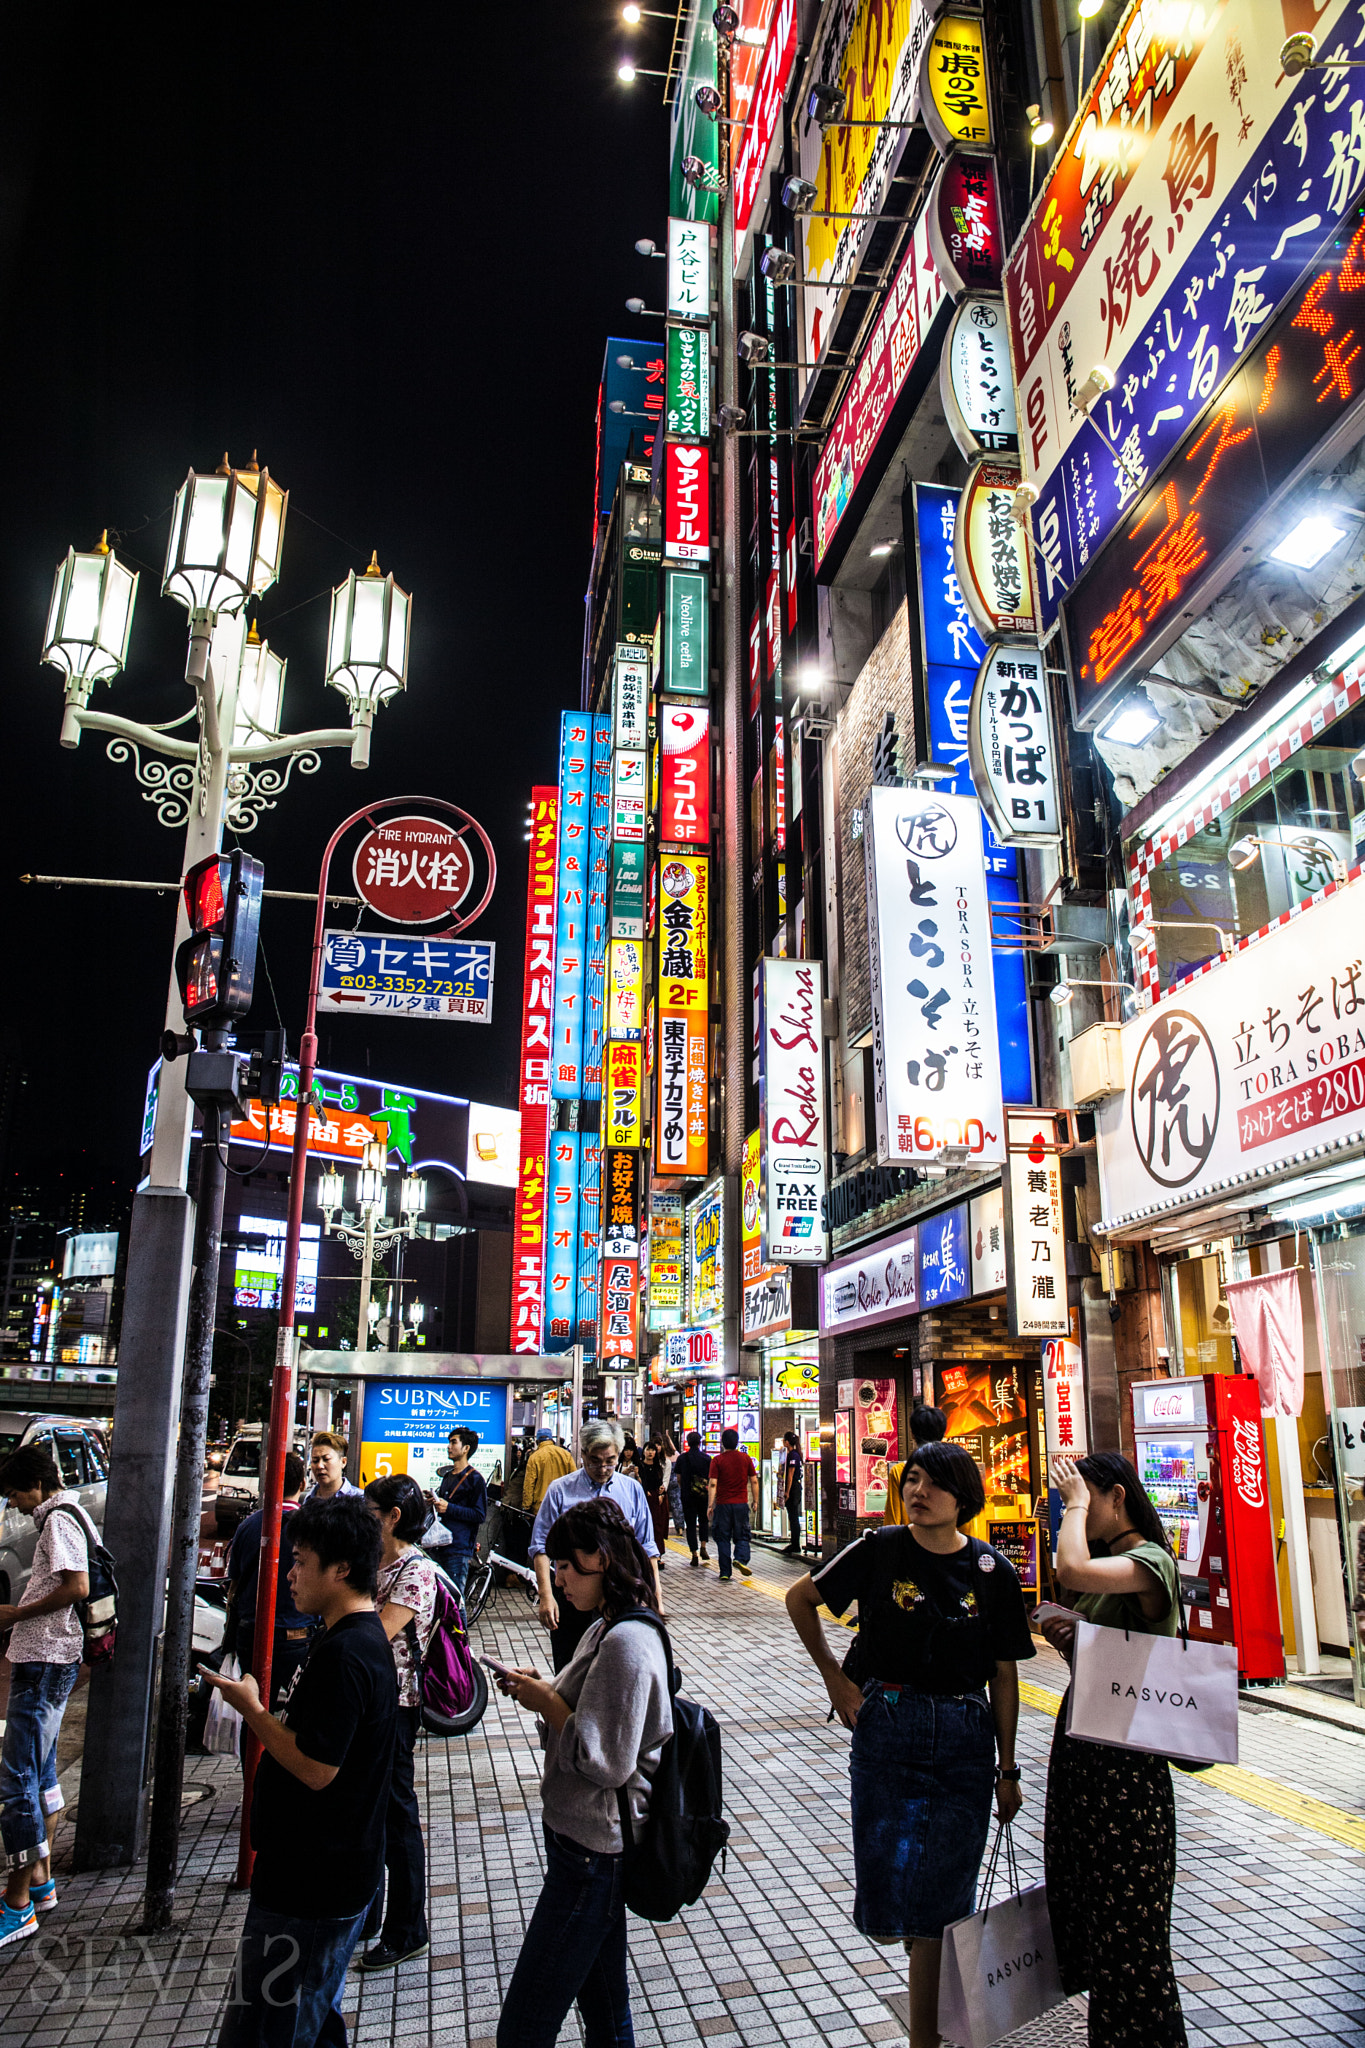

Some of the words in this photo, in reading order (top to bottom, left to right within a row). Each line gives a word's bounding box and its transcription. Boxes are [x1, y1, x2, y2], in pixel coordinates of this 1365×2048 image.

[936, 52, 983, 117] 虎の子
[957, 126, 986, 140] 4F
[1241, 159, 1278, 222] VS
[950, 234, 963, 262] 3F
[1100, 113, 1220, 360] 焼鳥
[677, 229, 702, 304] 戸谷ビル
[681, 311, 697, 320] 7F
[892, 305, 915, 358] TAX
[972, 305, 996, 328] 虎
[892, 324, 917, 390] FREE
[978, 331, 1006, 427] とらそば
[676, 342, 700, 435] もみの気ハウス
[667, 409, 680, 432] 6F
[979, 433, 1009, 449] 1F
[1026, 376, 1049, 472] 6F
[676, 466, 701, 542] アイフル
[678, 546, 698, 557] 5F
[986, 492, 1022, 613] お好み焼き
[1039, 496, 1064, 602] 5F
[1080, 511, 1209, 684] 営業
[997, 615, 1035, 632] 2階
[996, 660, 1038, 681] 新宿
[986, 691, 1003, 778] 生ビール190円酒場
[1000, 680, 1048, 786] かっぱ
[673, 757, 698, 821] アコム
[1010, 797, 1047, 821] B1
[378, 828, 402, 842] FIRE
[405, 830, 453, 846] HYDRANT
[535, 799, 557, 896] パチンコ
[674, 824, 697, 838] 3F
[365, 846, 463, 892] 消火栓
[617, 921, 638, 936] 3F
[955, 886, 970, 935] TORA
[625, 943, 641, 973] お好み
[660, 899, 694, 980] 金の蔵
[355, 974, 476, 997] 03-3352-7325
[906, 859, 959, 1093] とらそば
[960, 939, 974, 988] SOBA
[369, 992, 442, 1013] アルタ裏
[447, 998, 485, 1015] 買取
[616, 990, 636, 1024] 焼き
[668, 983, 698, 1006] 2F
[768, 966, 820, 1054] Shira
[1232, 959, 1365, 1071] 立ちそば
[628, 1028, 640, 1039] 7F
[689, 1036, 706, 1066] 元祖
[961, 998, 984, 1080] 立ちそば
[611, 1045, 638, 1089] 麻雀
[1240, 1059, 1299, 1101] TORA
[1307, 1026, 1365, 1073] SOBA
[611, 1088, 637, 1127] ブル
[662, 1020, 688, 1162] 東京チカラめし
[687, 1066, 706, 1136] 焼き牛丼
[770, 1063, 820, 1149] Roko
[1138, 1017, 1214, 1168] 虎
[614, 1130, 632, 1144] 6F
[897, 1114, 914, 1153] 早朝
[1240, 1087, 1314, 1145] かけそば
[521, 1155, 544, 1244] パチンコ
[611, 1151, 634, 1225] お好み焼
[775, 1182, 817, 1197] TAX
[776, 1197, 818, 1211] FREE
[550, 1144, 573, 1338] カラオケ館
[607, 1224, 637, 1240] 本陣
[611, 1241, 632, 1254] 8F
[772, 1244, 823, 1256] ロコシーラ
[1027, 1169, 1056, 1299] 養老乃瀧
[515, 1256, 541, 1354] エスパス
[608, 1265, 632, 1335] 居酒屋
[604, 1338, 634, 1354] 本陣
[1022, 1320, 1067, 1330] 24時間営業
[608, 1356, 630, 1370] 4F
[1046, 1340, 1067, 1380] 24
[379, 1388, 491, 1410] SUBNADE
[410, 1408, 460, 1418] 新宿サブナード
[1056, 1380, 1074, 1447] 営業
[403, 1422, 436, 1430] ファッション
[374, 1452, 393, 1479] 5
[1232, 1414, 1265, 1508] Coca-Cola
[1110, 1681, 1199, 1711] RASVOA
[987, 1947, 1044, 1990] RASVOA
